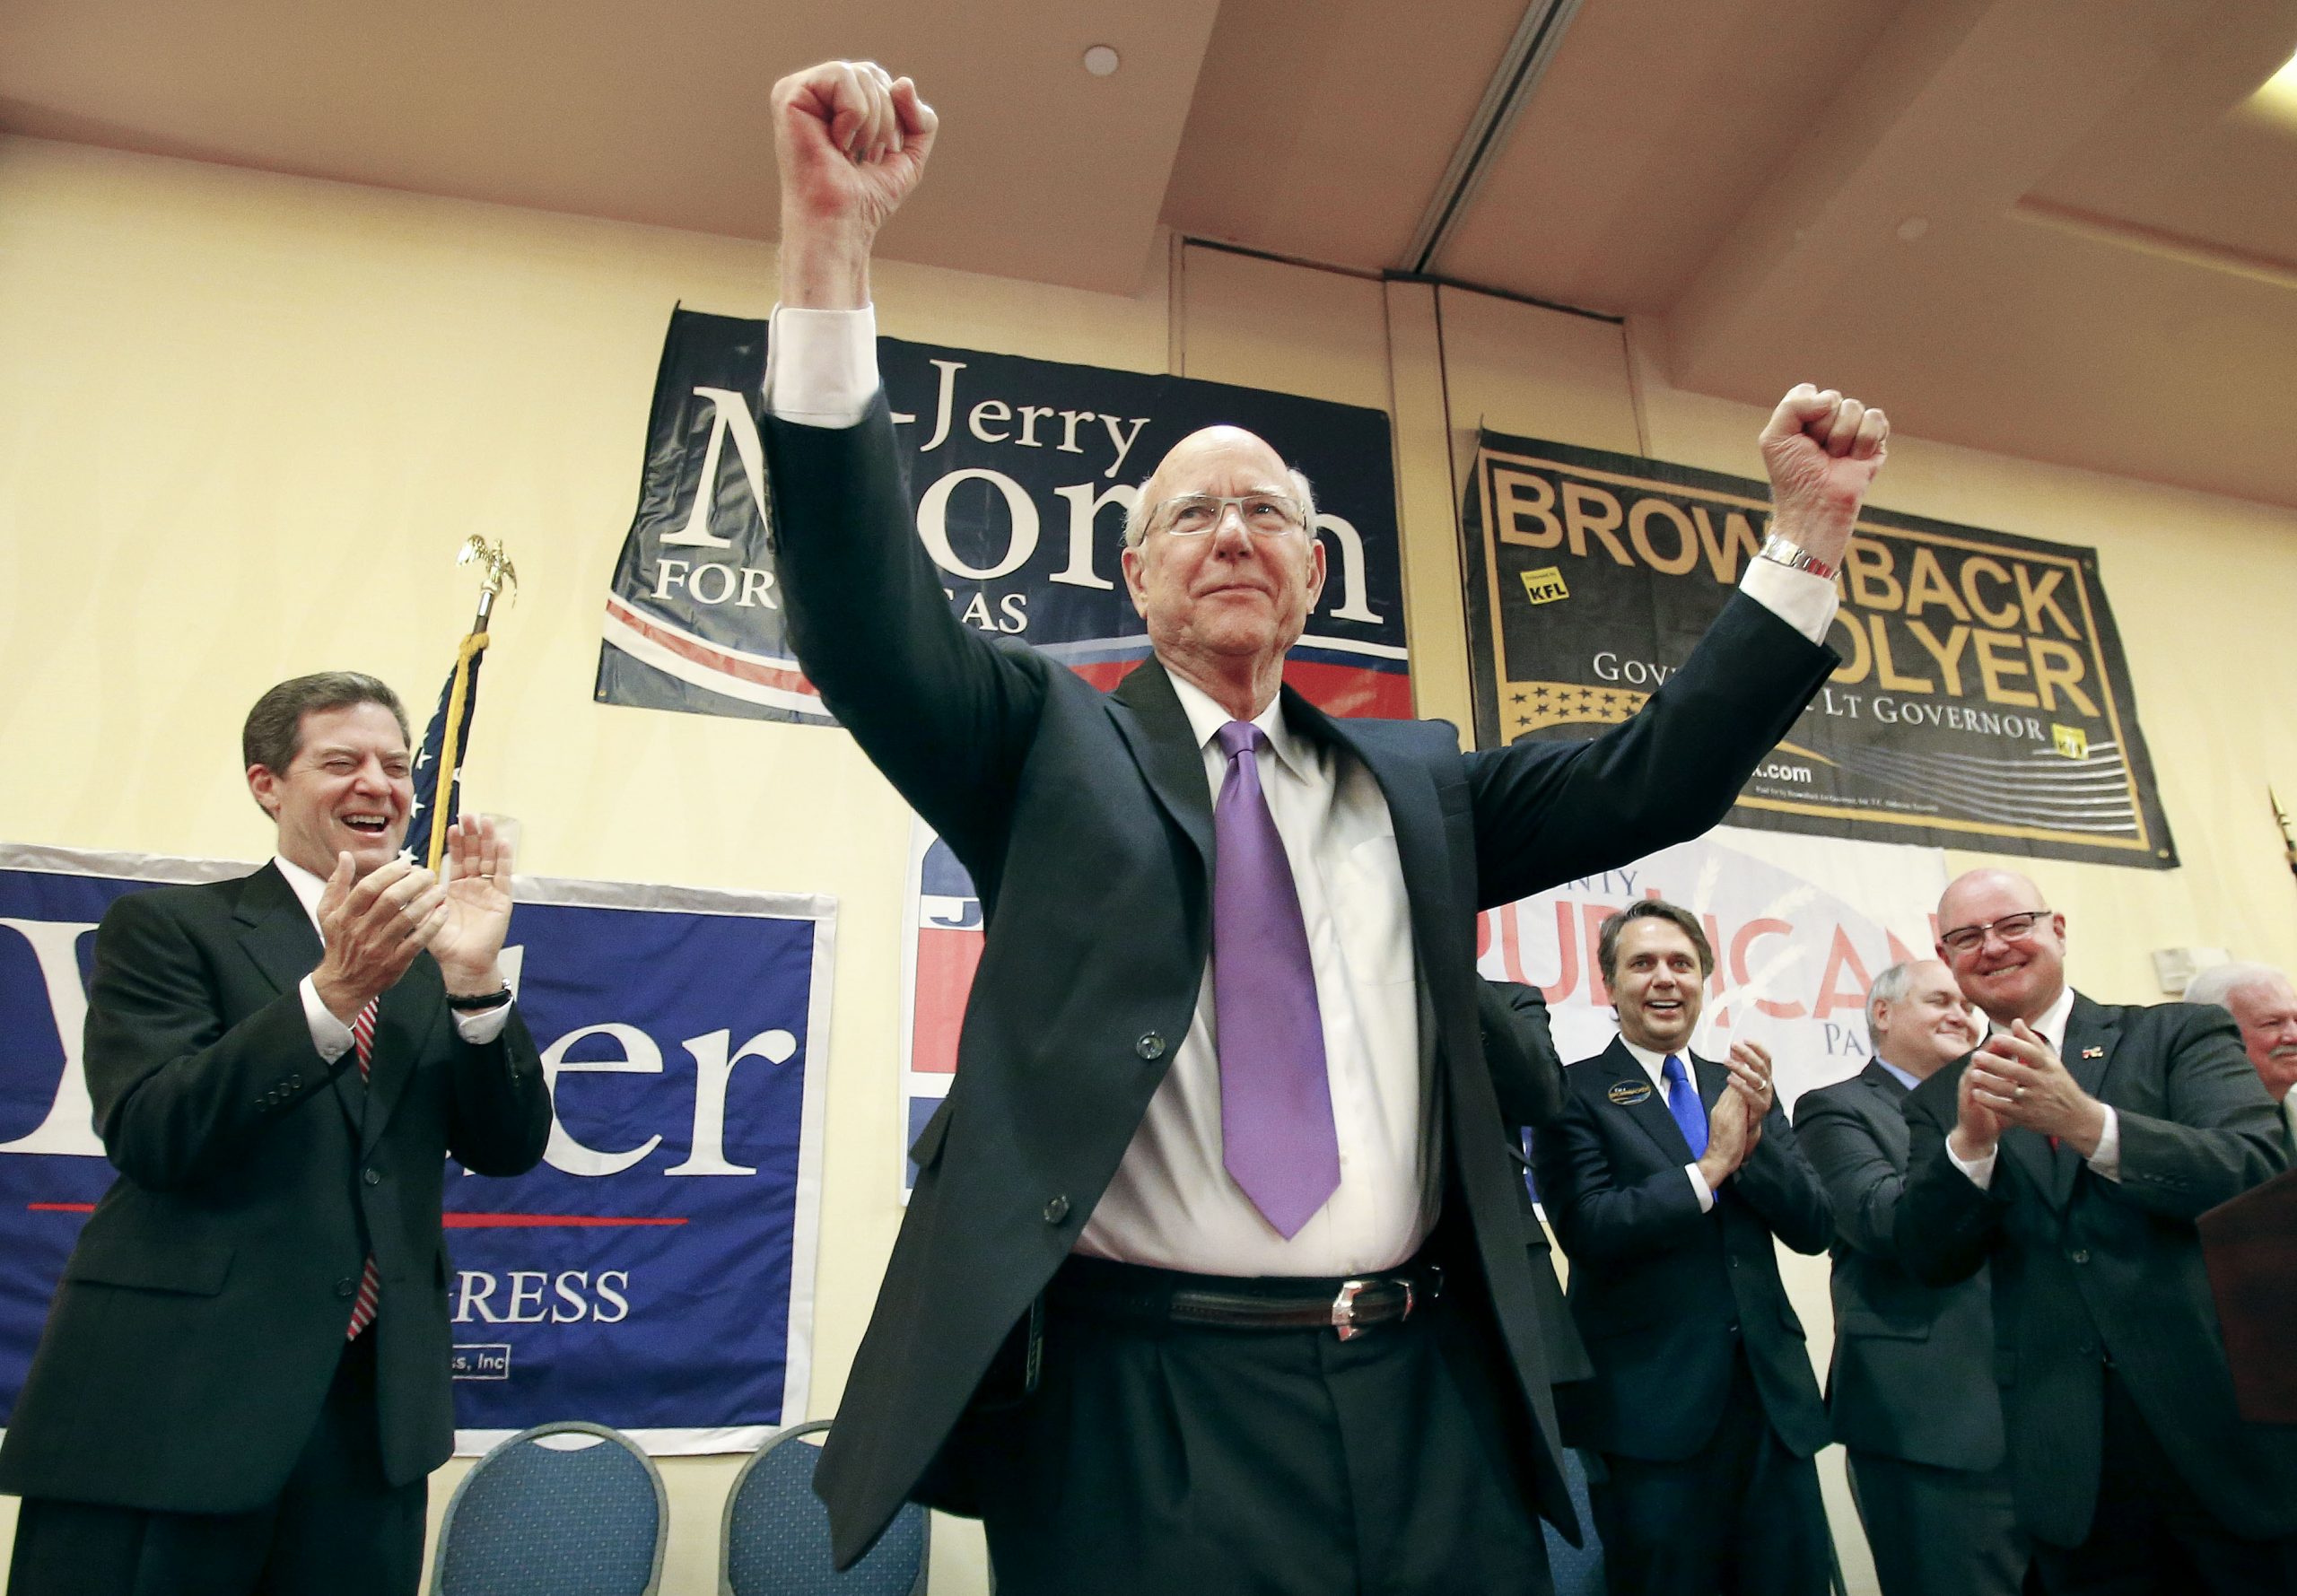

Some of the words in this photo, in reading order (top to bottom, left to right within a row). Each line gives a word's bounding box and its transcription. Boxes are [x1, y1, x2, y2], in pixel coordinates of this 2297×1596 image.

[920, 359, 1151, 479] Jerry
[659, 387, 1384, 625] Morn
[651, 559, 778, 610] FOR
[1493, 467, 2083, 641] BROWBACK
[1529, 583, 1567, 600] KFL
[1829, 607, 2101, 718] OLYER
[1873, 696, 2046, 742] GOVERNOR
[477, 1353, 505, 1370] Inc
